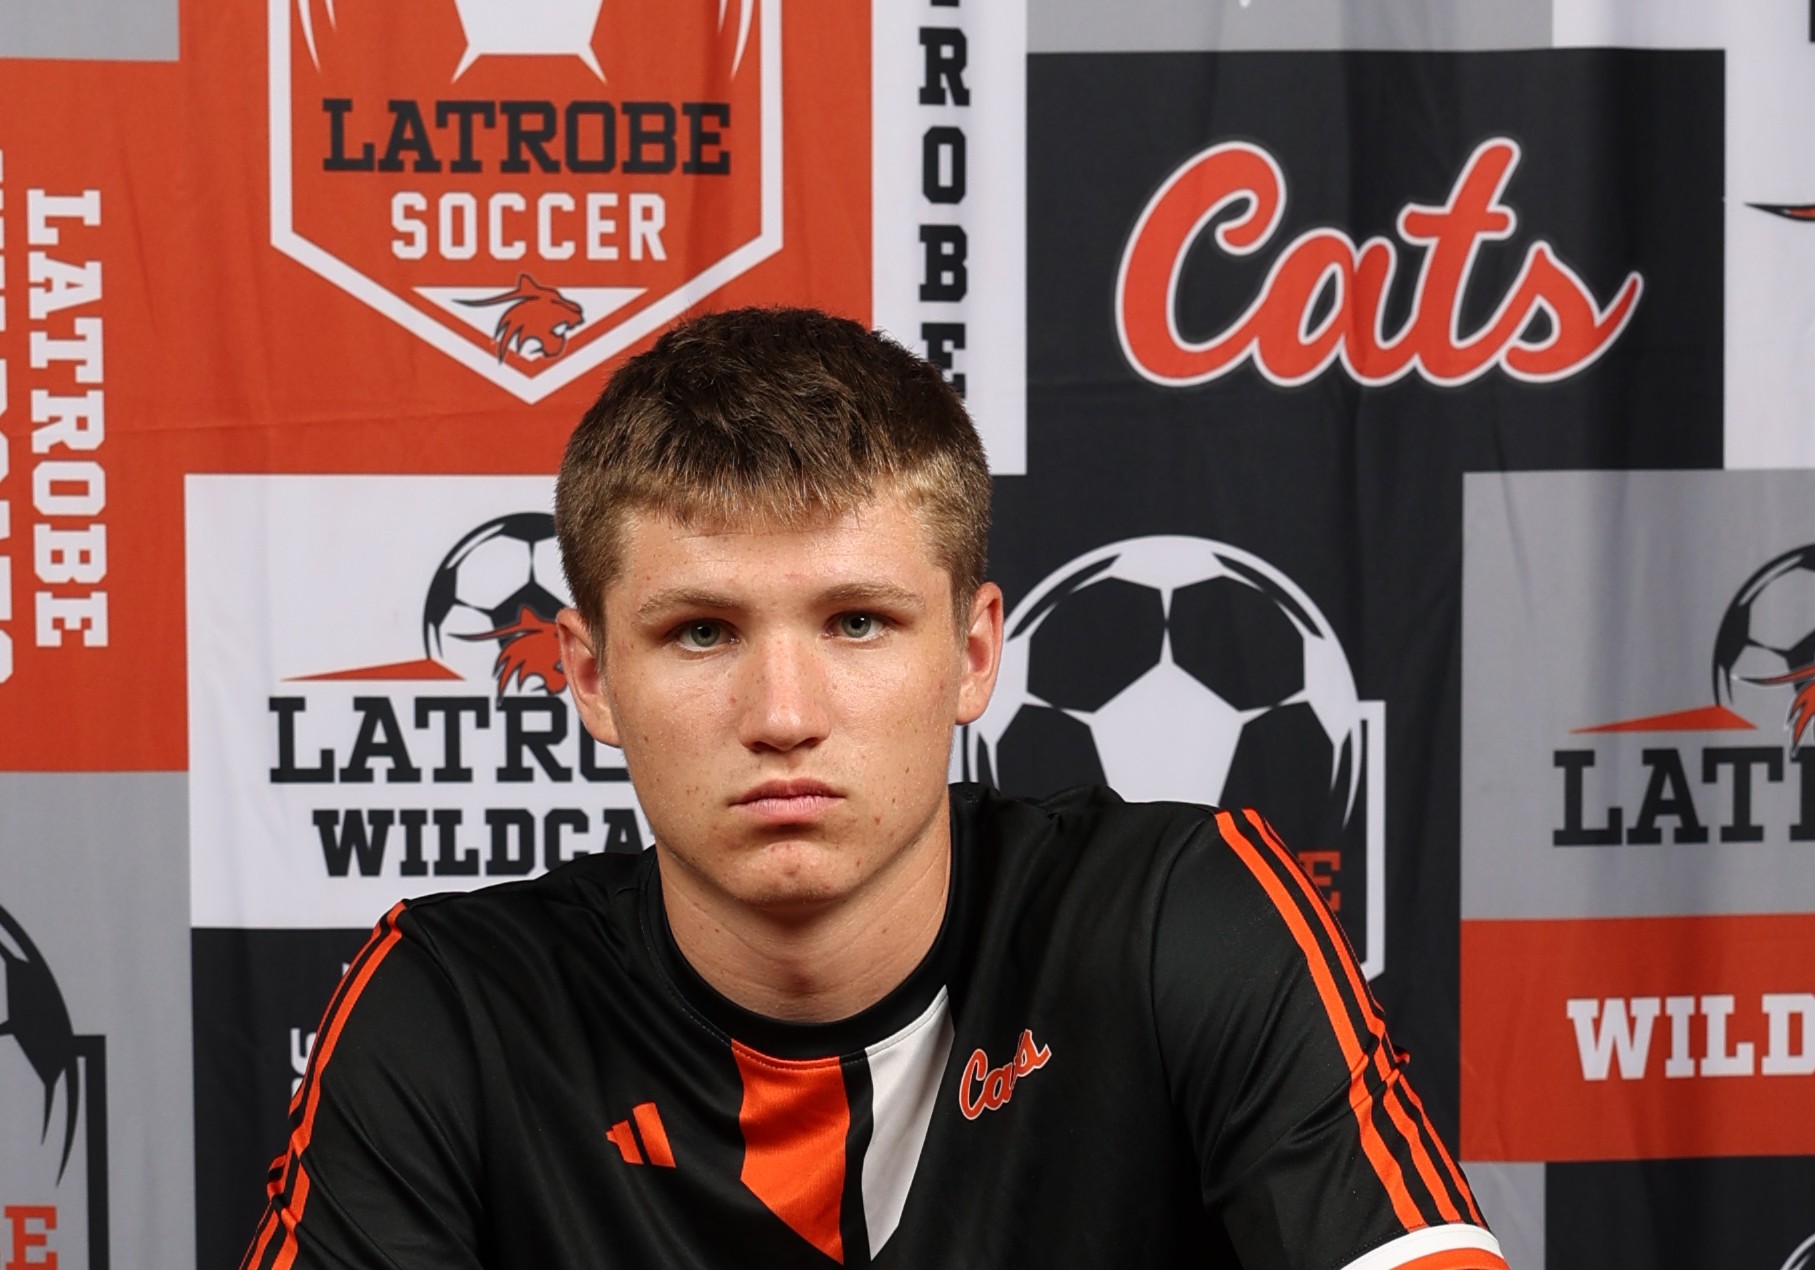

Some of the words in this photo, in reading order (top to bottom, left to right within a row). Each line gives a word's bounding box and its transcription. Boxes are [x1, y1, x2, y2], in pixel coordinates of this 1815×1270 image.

[322, 98, 732, 176] LATROBE
[918, 0, 971, 398] ROBE
[390, 192, 668, 262] SOCCER
[1114, 137, 1645, 387] Cats
[26, 188, 109, 648] LATROBE
[1566, 993, 1815, 1082] WILD
